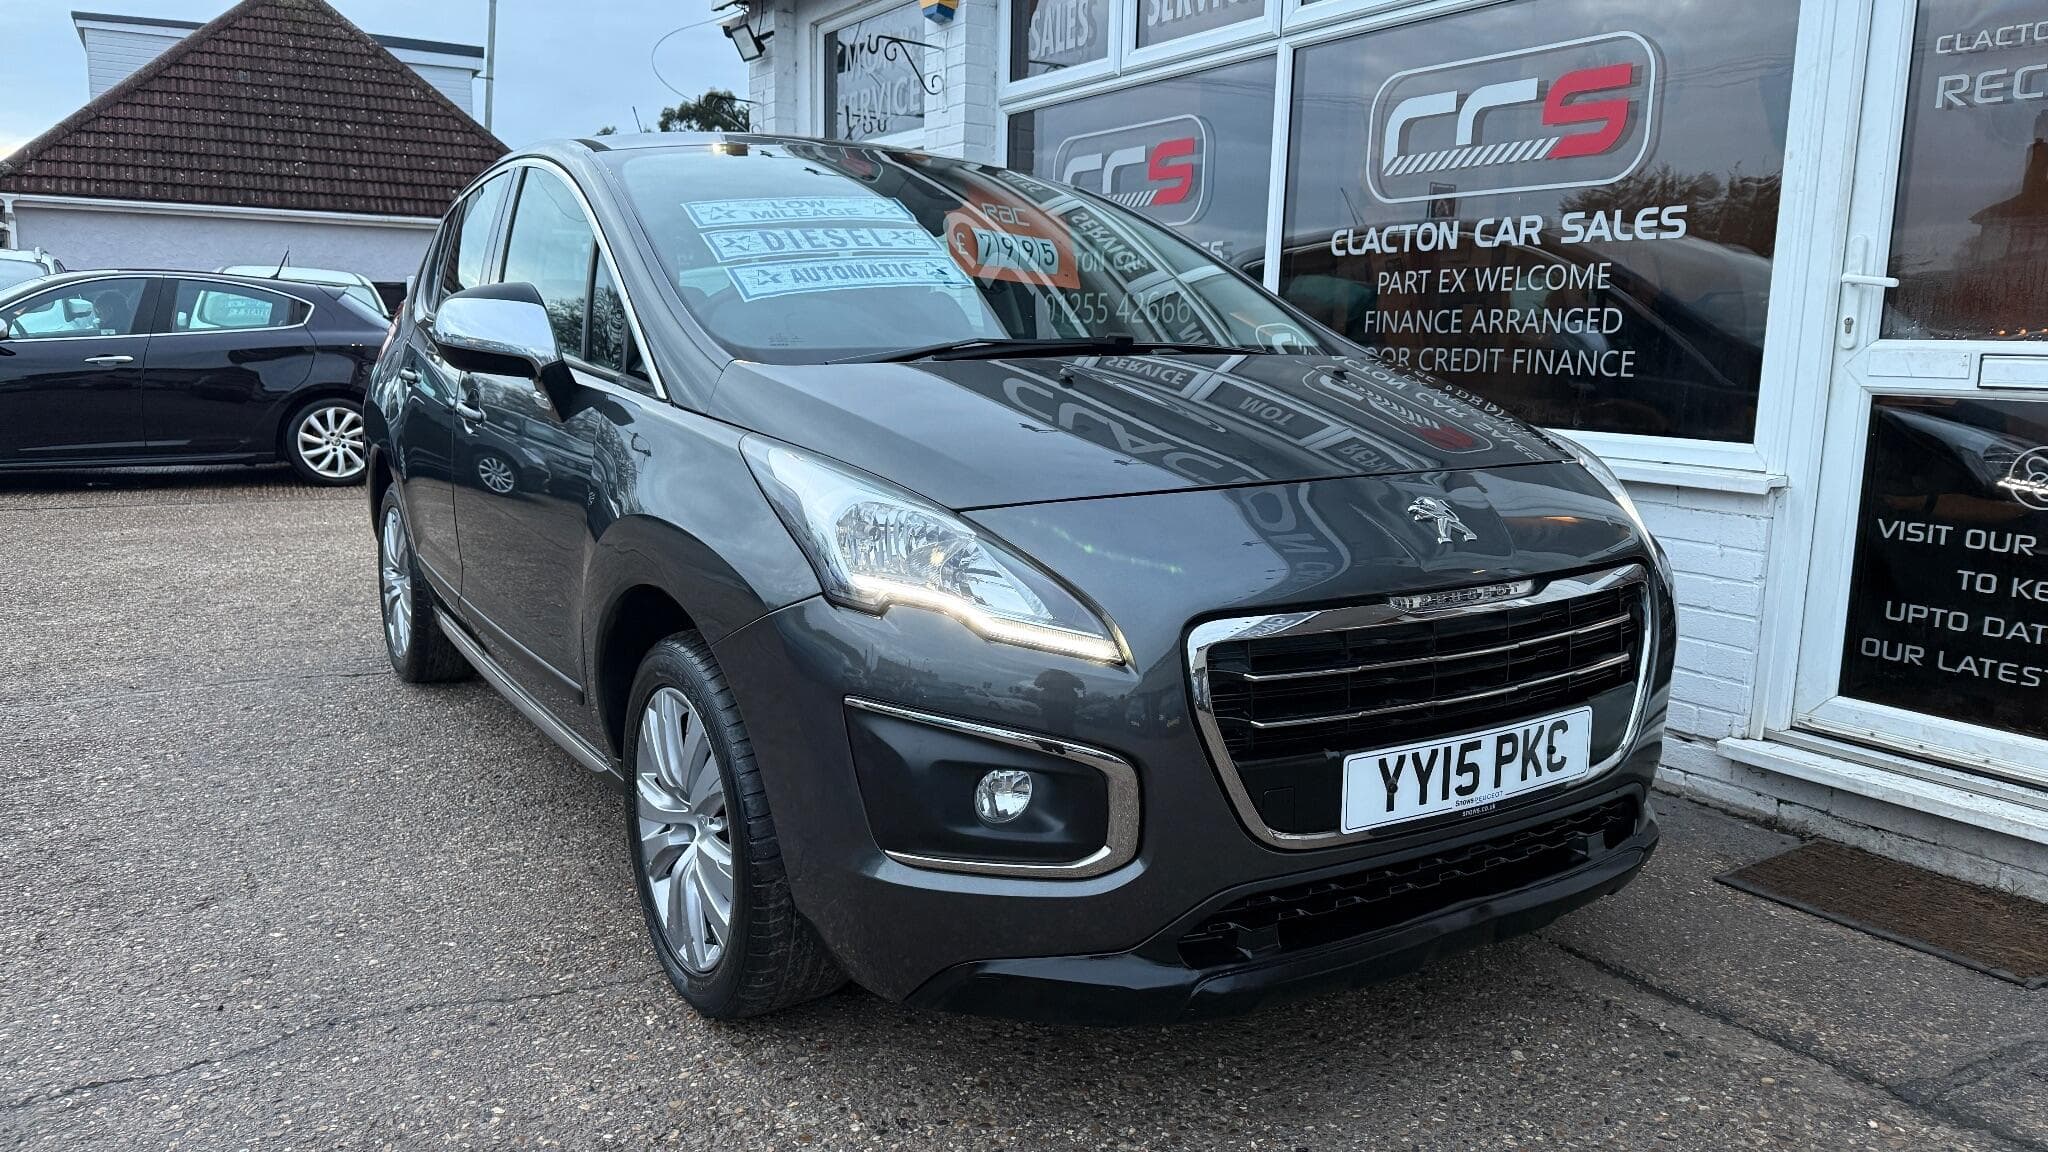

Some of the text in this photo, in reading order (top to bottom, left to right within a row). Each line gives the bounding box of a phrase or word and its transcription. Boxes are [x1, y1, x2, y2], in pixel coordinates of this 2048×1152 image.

[1029, 0, 1089, 60] SALES
[750, 208, 863, 220] MILEAGE
[771, 200, 825, 210] LOW
[758, 228, 893, 251] DIESEL
[1331, 204, 1688, 256] CLACTON CAR SALES
[790, 263, 917, 284] AUTOMATIC
[1377, 262, 1612, 296] PART EX WELCOME
[1364, 307, 1623, 336] FINANCE ARRANGED
[1418, 347, 1504, 374] CREDIT
[1512, 347, 1636, 378] FINANCE
[1878, 518, 2037, 556] VISIT OUR
[1957, 569, 1998, 594] TO
[1885, 600, 2048, 645] UPTO DAT
[1861, 637, 2048, 688] OUR LATES
[1377, 718, 1569, 813] YY15 PKC
